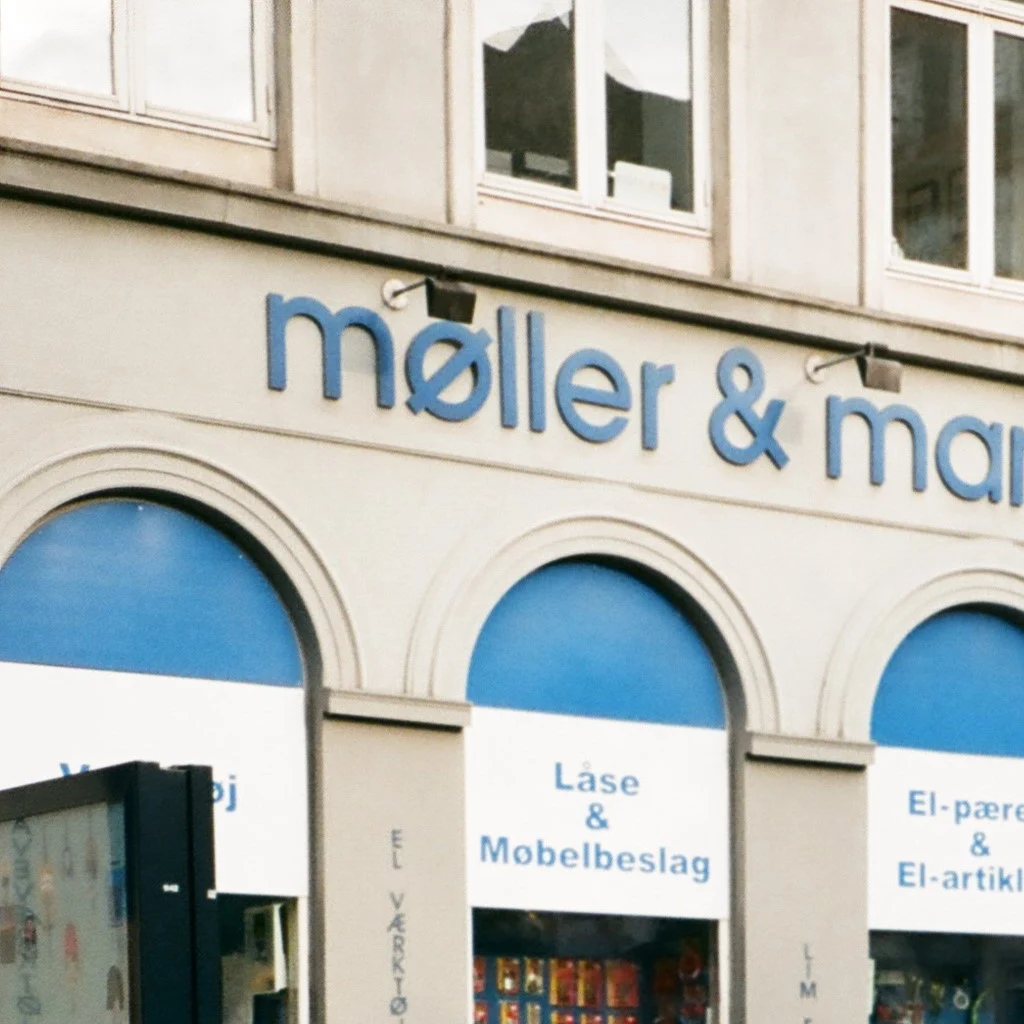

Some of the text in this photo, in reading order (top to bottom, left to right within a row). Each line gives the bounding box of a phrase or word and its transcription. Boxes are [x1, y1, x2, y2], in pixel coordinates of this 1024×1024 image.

[266, 292, 676, 450] møller
[709, 346, 789, 470] &
[554, 760, 640, 795] Låse
[585, 802, 609, 830] &
[390, 828, 403, 871] EL
[479, 834, 711, 884] Møbelbeslag
[969, 831, 991, 857] &
[800, 942, 817, 999] LIM
